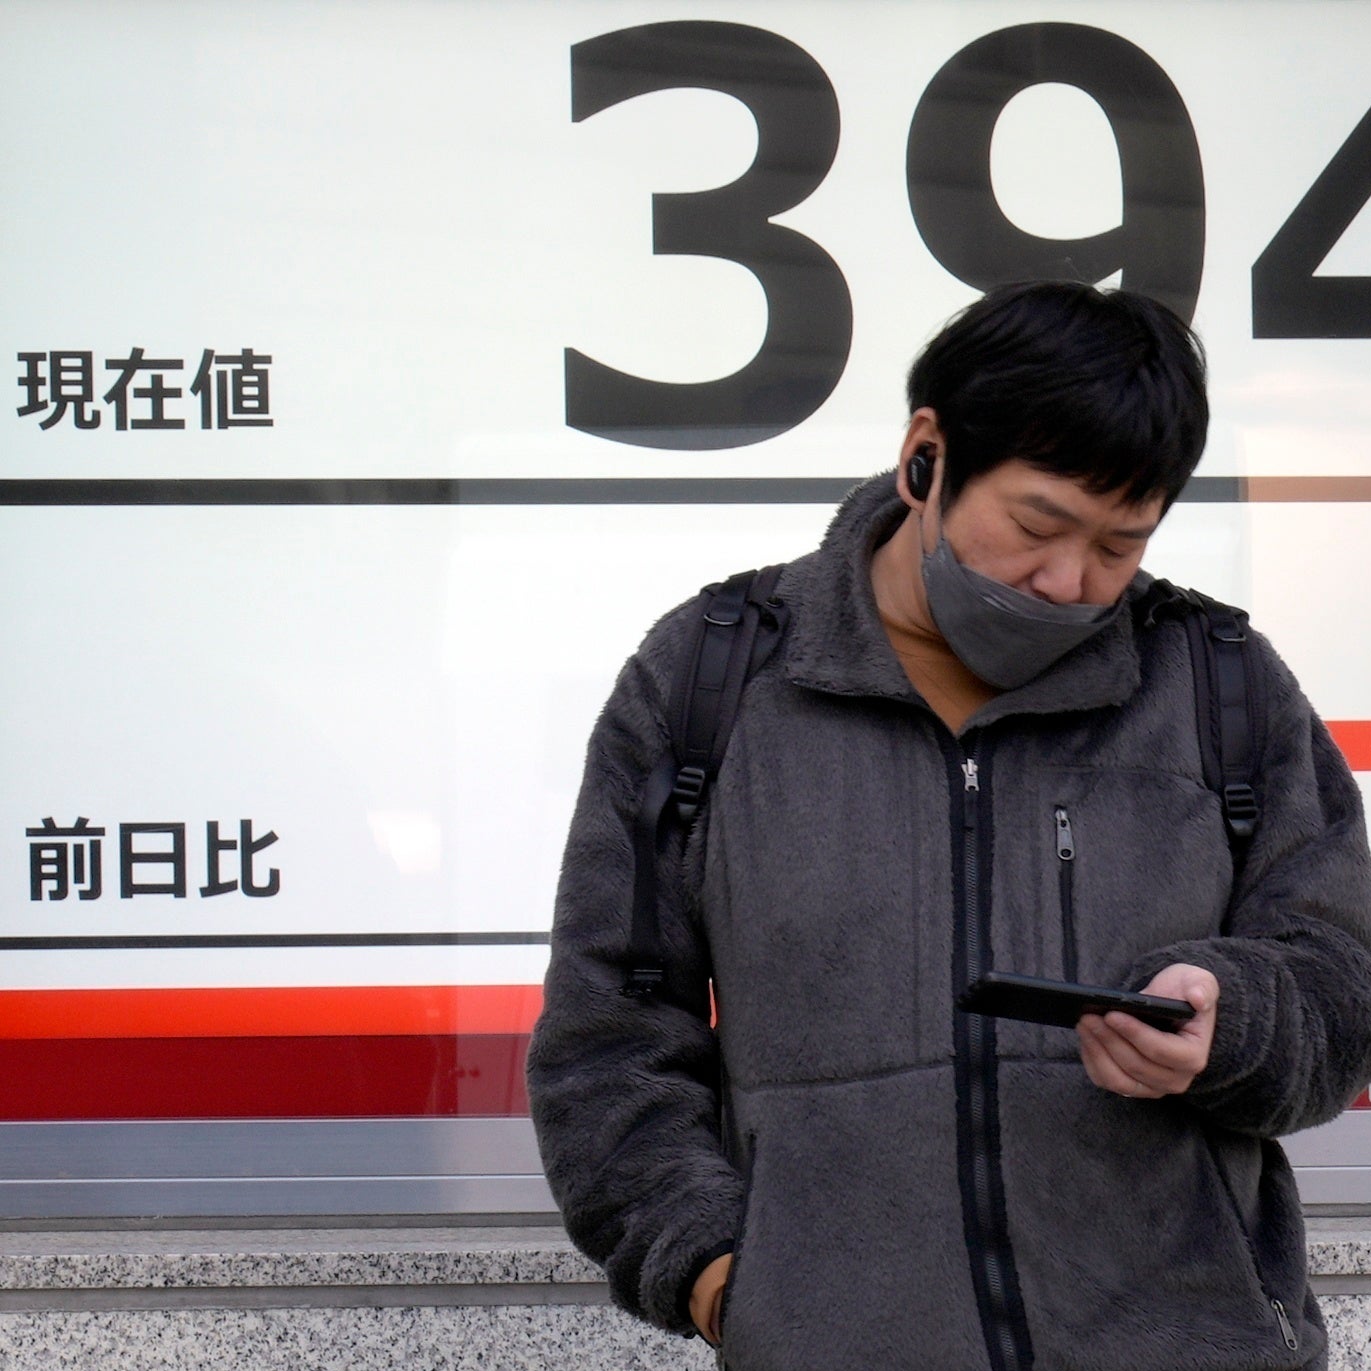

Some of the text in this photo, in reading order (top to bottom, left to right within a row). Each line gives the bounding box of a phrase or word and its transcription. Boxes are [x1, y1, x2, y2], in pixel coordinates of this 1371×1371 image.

[16, 347, 274, 431] 現在値
[25, 816, 281, 901] 前日比
